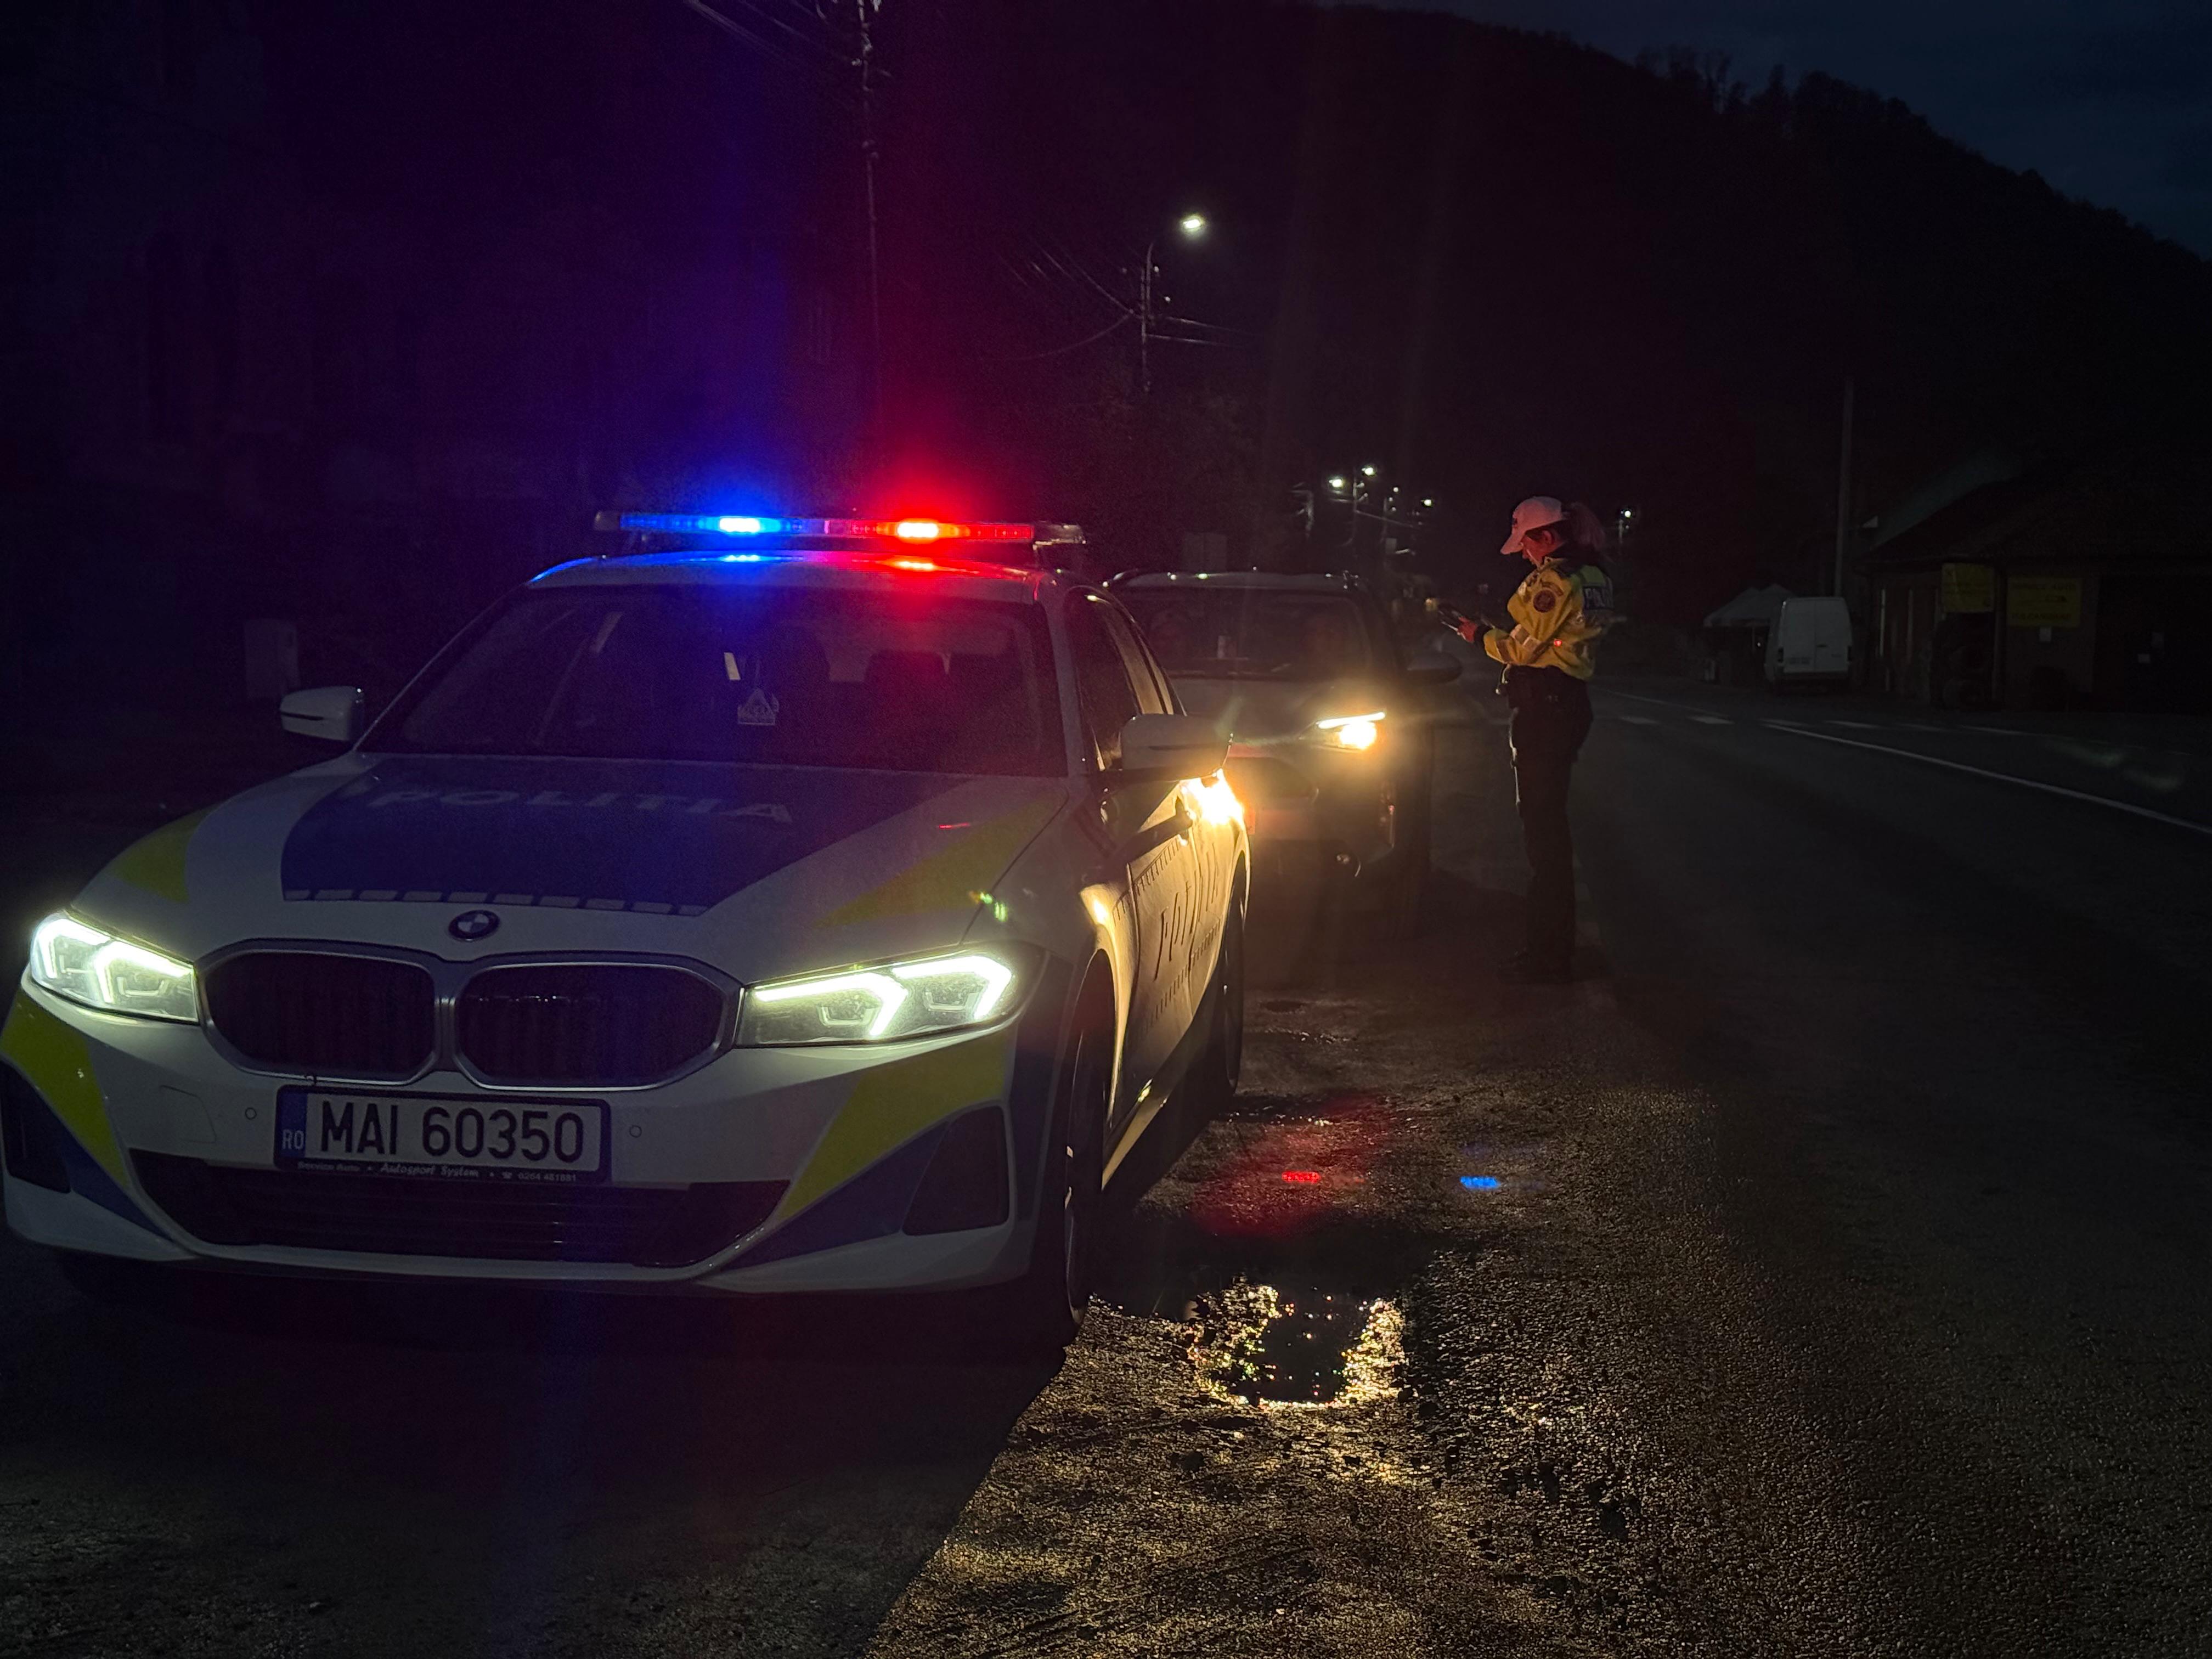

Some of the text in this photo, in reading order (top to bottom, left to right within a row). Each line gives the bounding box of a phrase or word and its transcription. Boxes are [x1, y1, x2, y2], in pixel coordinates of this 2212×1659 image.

[282, 1129, 304, 1150] RO
[320, 1101, 584, 1164] MAI 60350
[380, 1161, 436, 1176] Autosport
[441, 1164, 479, 1178] System
